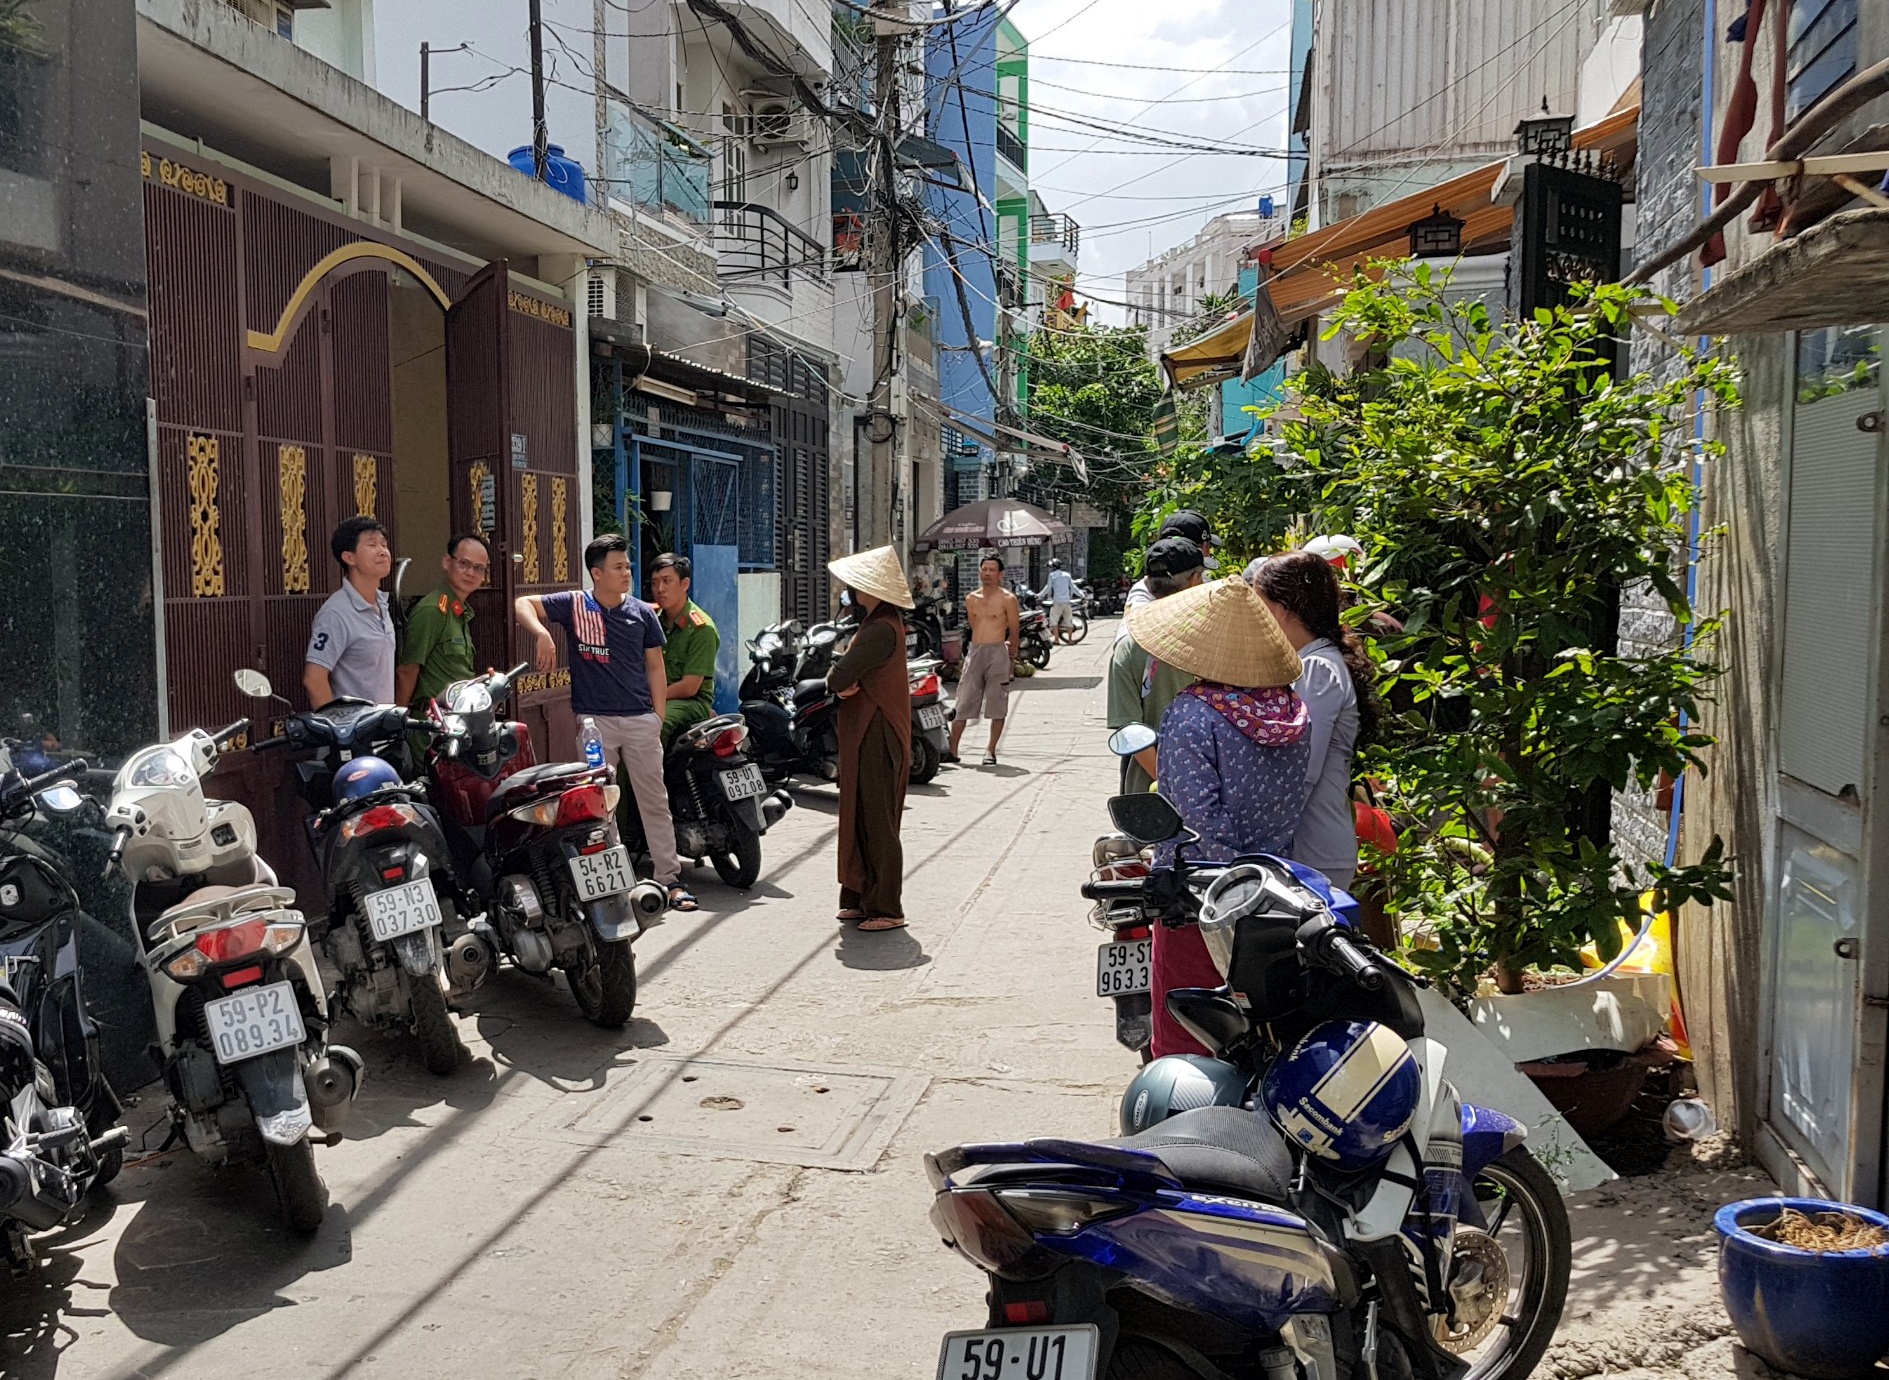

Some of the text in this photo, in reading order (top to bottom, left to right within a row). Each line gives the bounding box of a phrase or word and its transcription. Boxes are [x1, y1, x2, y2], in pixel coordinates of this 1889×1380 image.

[313, 632, 329, 651] 3
[591, 646, 610, 656] TRUE
[726, 768, 755, 784] 59-U1
[728, 780, 764, 798] 092.08
[579, 852, 622, 876] 54-R2
[585, 871, 626, 895] 6621
[376, 885, 424, 913] 59-N3
[377, 903, 437, 935] 037.30
[1108, 941, 1152, 967] 59-S1
[1102, 966, 1149, 992] 963.3
[219, 989, 284, 1027] 59-P2
[220, 1014, 299, 1057] 089.34
[961, 1335, 1066, 1380] 59-U1
